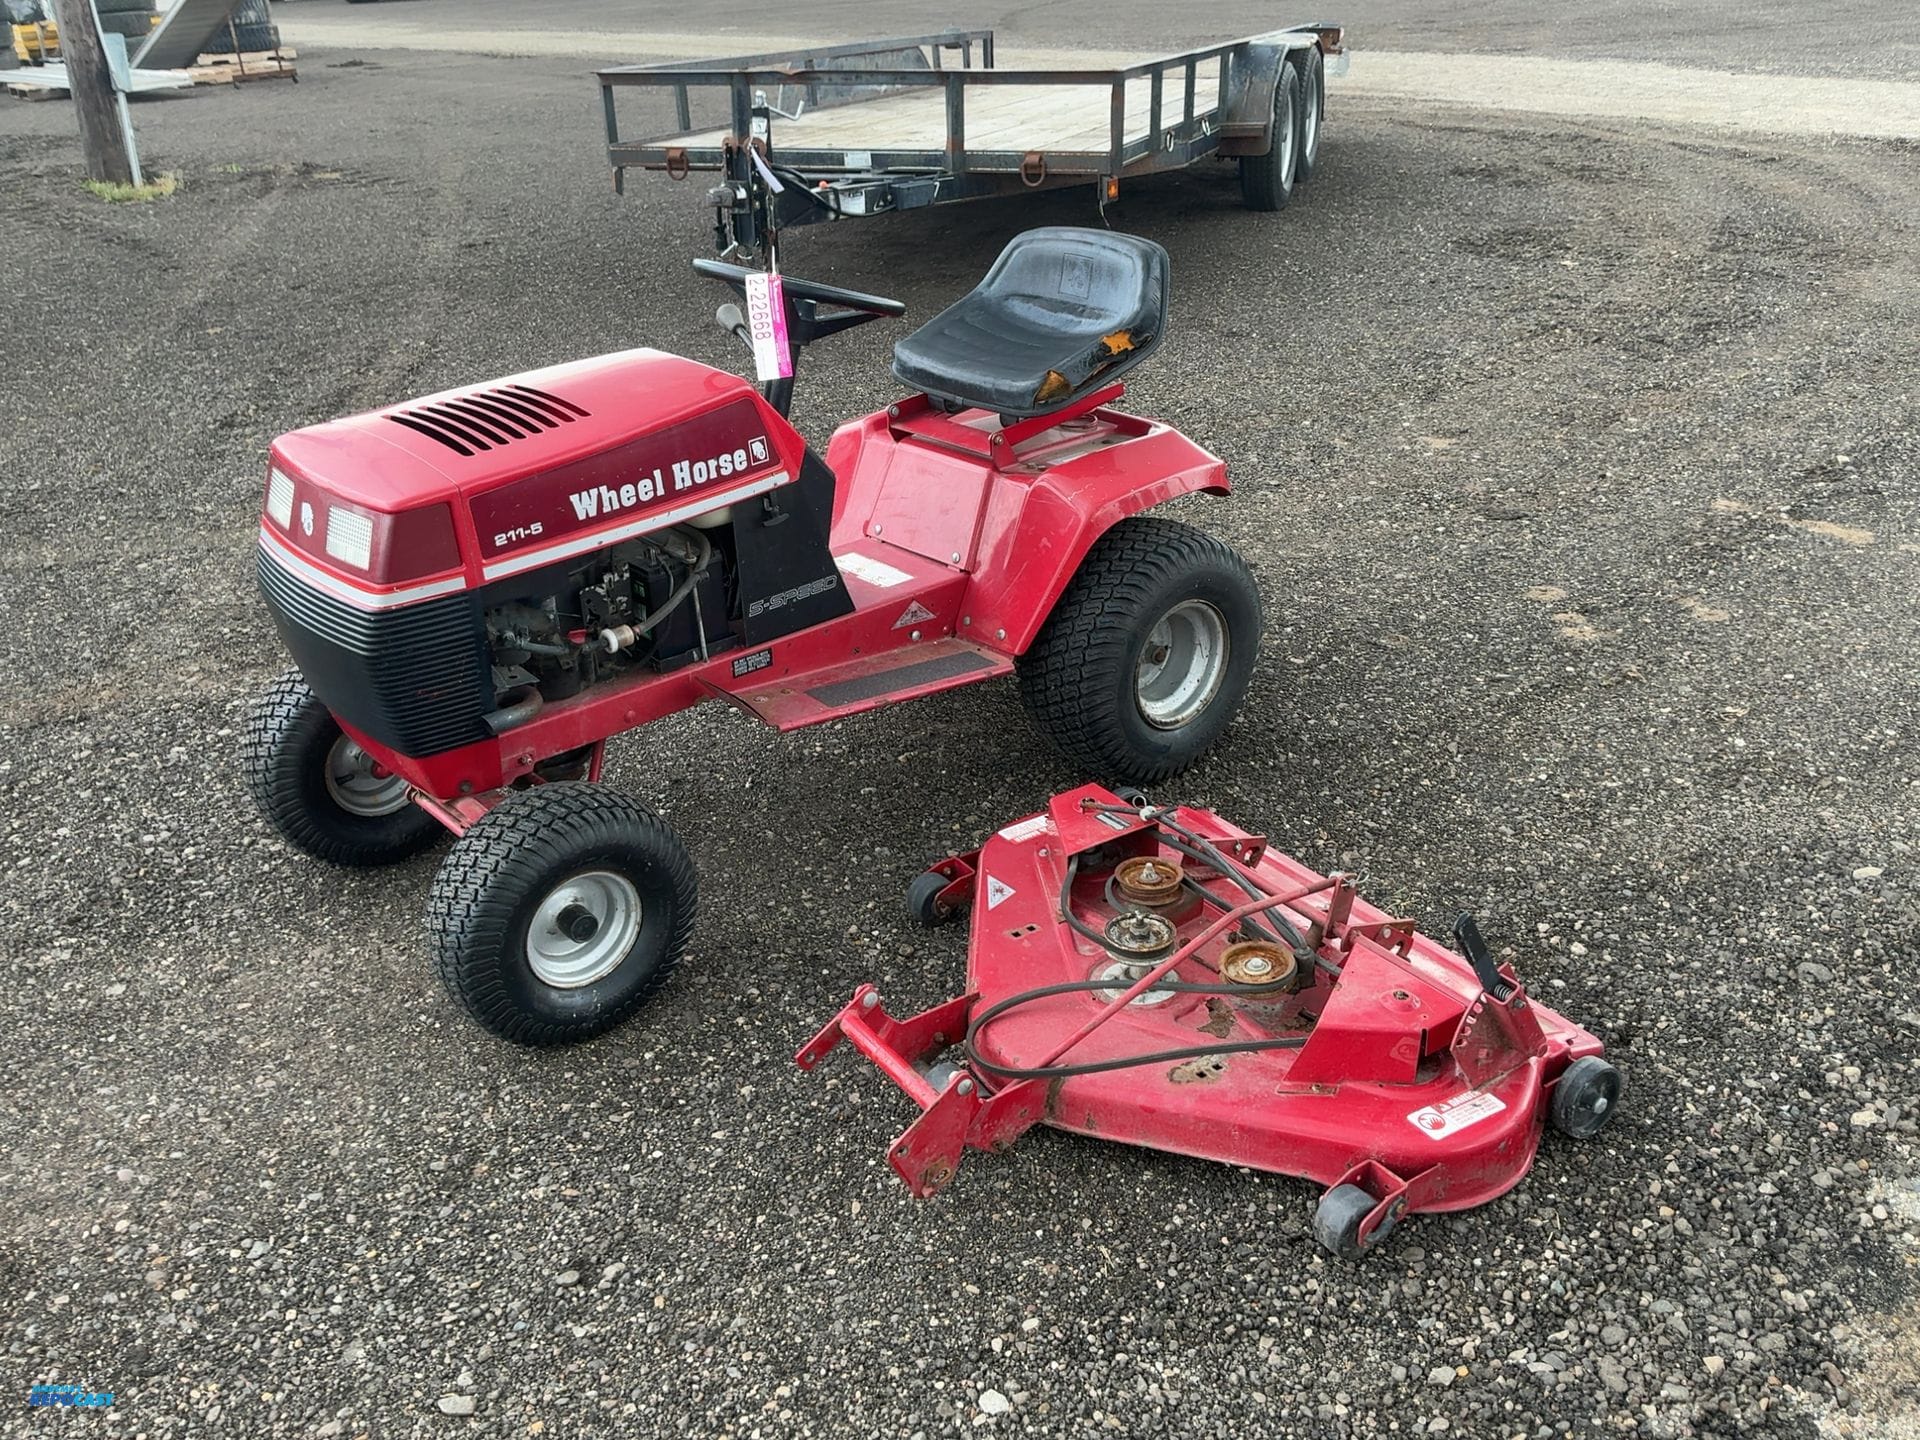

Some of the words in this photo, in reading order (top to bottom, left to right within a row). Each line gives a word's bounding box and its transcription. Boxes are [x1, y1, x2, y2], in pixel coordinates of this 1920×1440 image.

[749, 278, 771, 340] 2-22668
[569, 469, 665, 521] Wheel
[672, 448, 749, 490] Horse
[494, 521, 543, 547] 211-5
[749, 575, 837, 617] 5-SPEED
